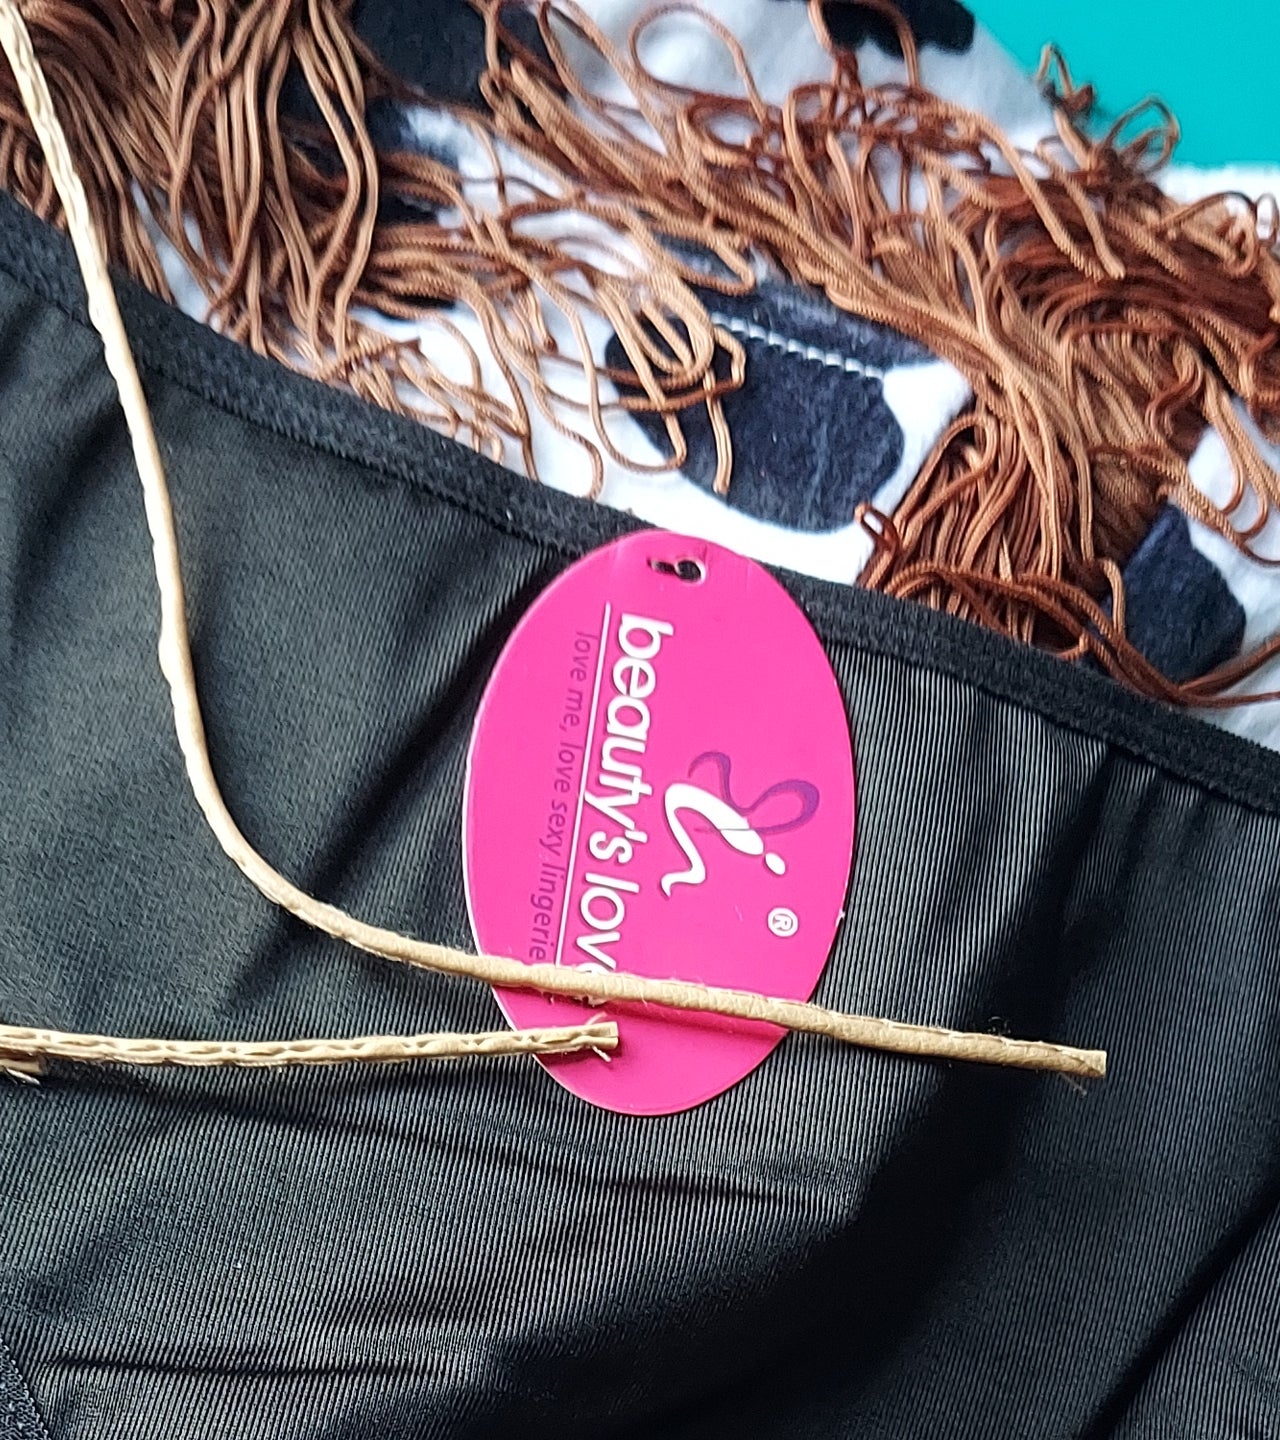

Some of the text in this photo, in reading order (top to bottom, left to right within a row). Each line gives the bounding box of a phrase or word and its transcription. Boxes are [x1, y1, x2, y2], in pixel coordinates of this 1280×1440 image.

[528, 630, 599, 961] love me, love sexy lingerie
[583, 612, 675, 865] beauty's
